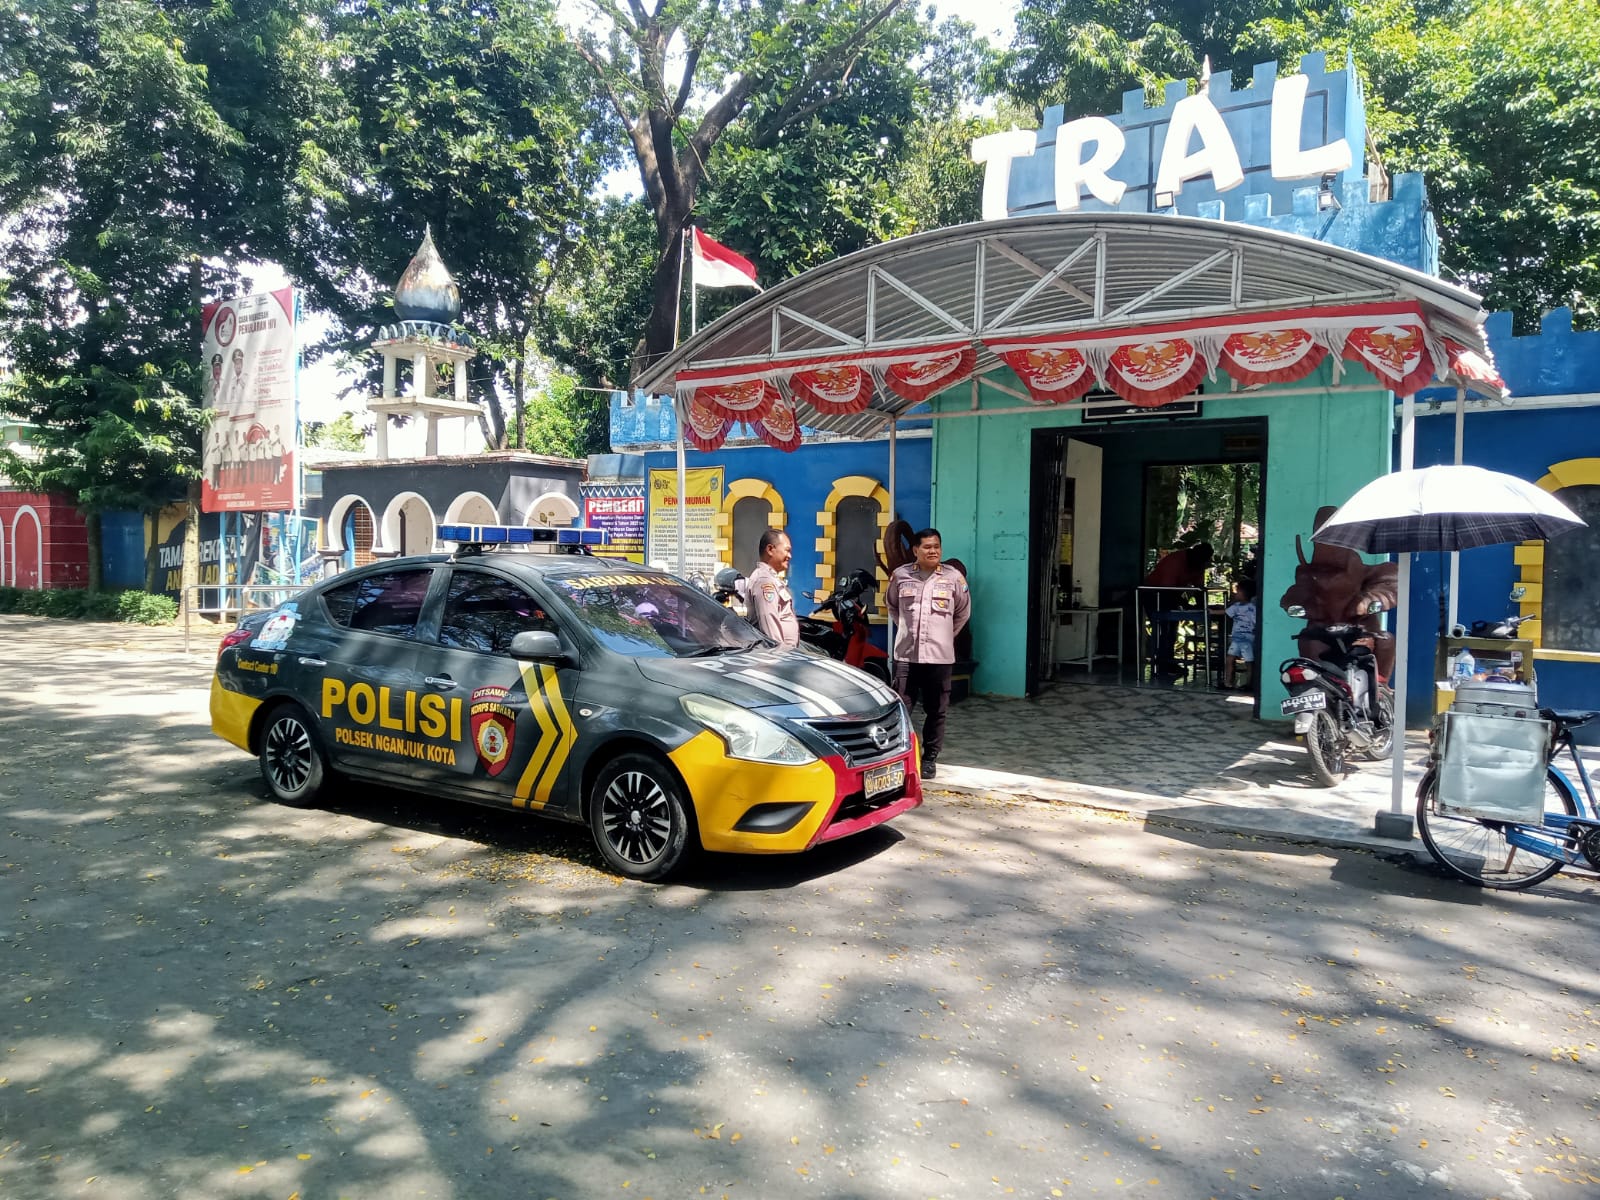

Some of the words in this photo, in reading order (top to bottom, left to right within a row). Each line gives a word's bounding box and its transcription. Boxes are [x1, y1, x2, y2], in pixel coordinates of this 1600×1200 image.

[971, 73, 1352, 221] TRAL
[664, 496, 711, 505] PENMUMAN
[566, 576, 656, 589] SABHARA
[321, 677, 462, 742] POLISI
[471, 702, 489, 716] KORPS
[335, 727, 374, 747] POLSEK
[375, 734, 425, 760] NGANJUK
[427, 743, 456, 766] KOTA
